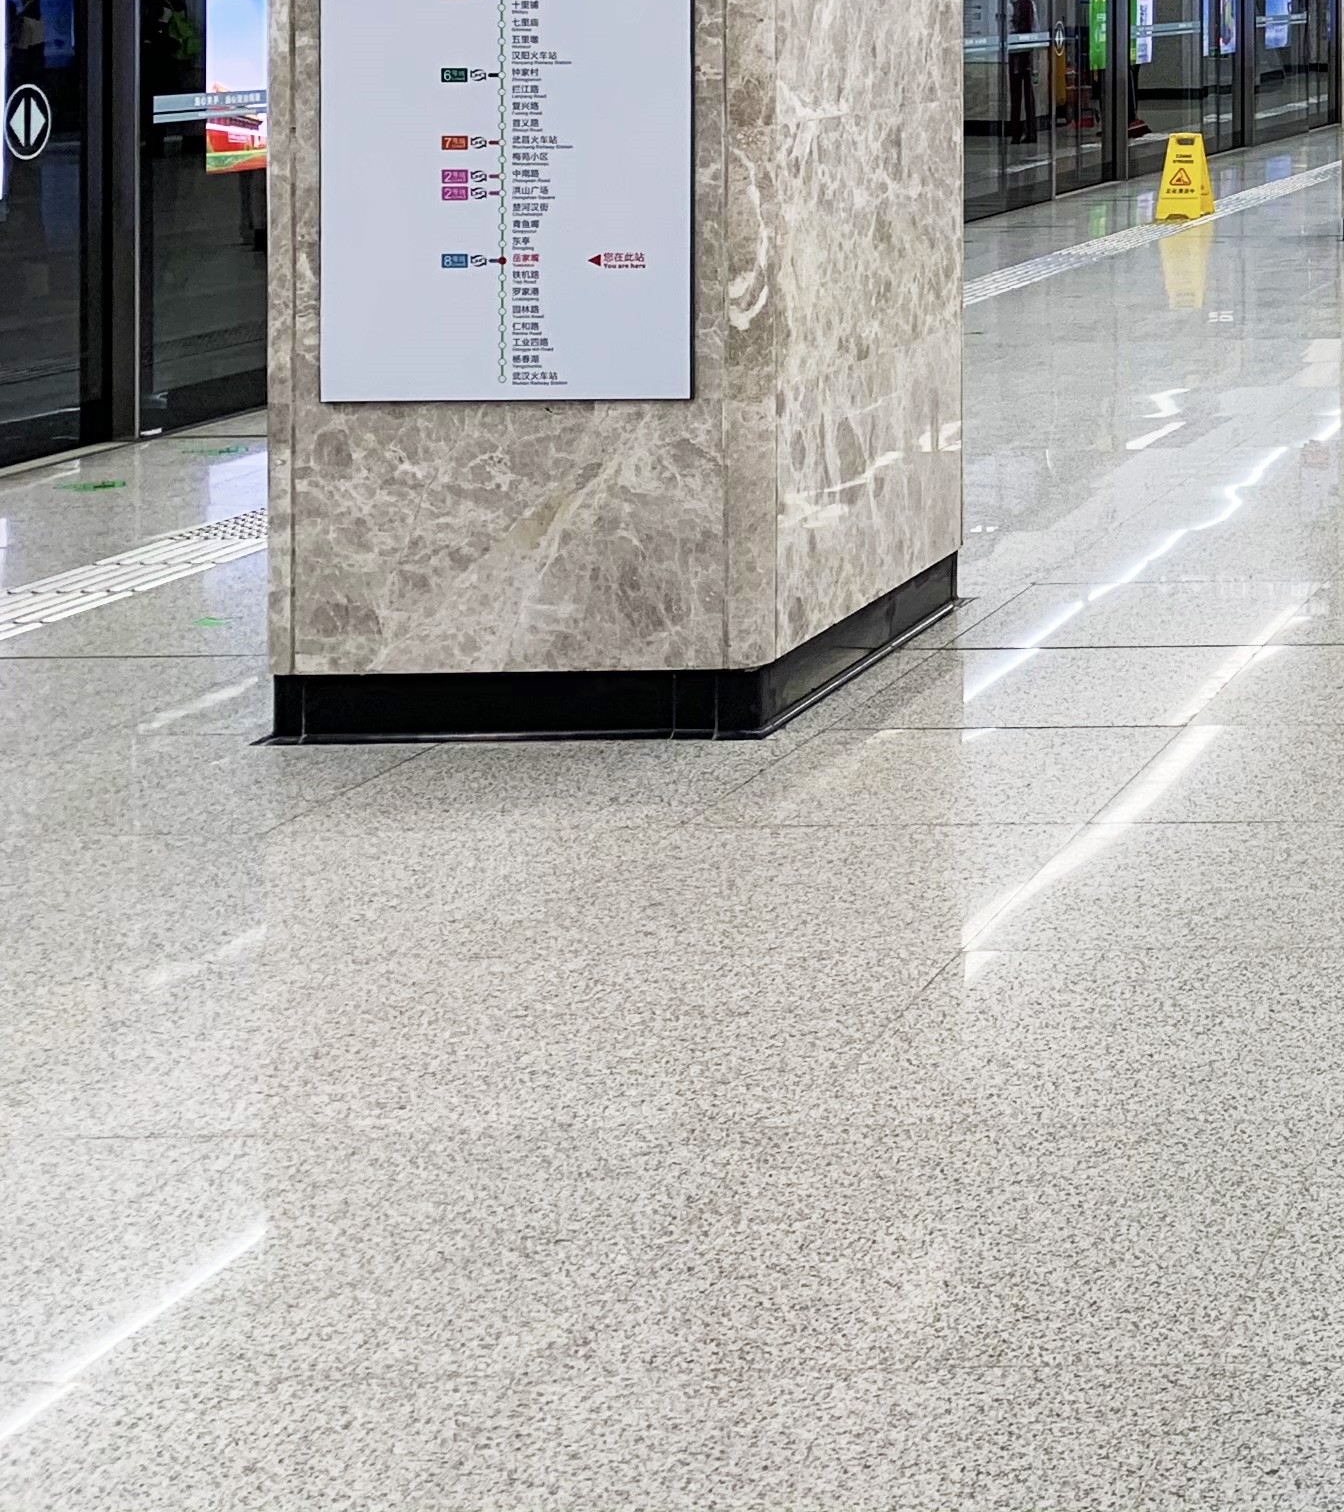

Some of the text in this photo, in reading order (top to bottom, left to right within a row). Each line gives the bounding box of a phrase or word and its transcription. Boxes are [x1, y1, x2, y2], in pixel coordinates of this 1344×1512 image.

[511, 50, 558, 61] 汉阳火车站
[603, 252, 645, 263] 您在此站
[511, 371, 558, 381] 武汉火车站
